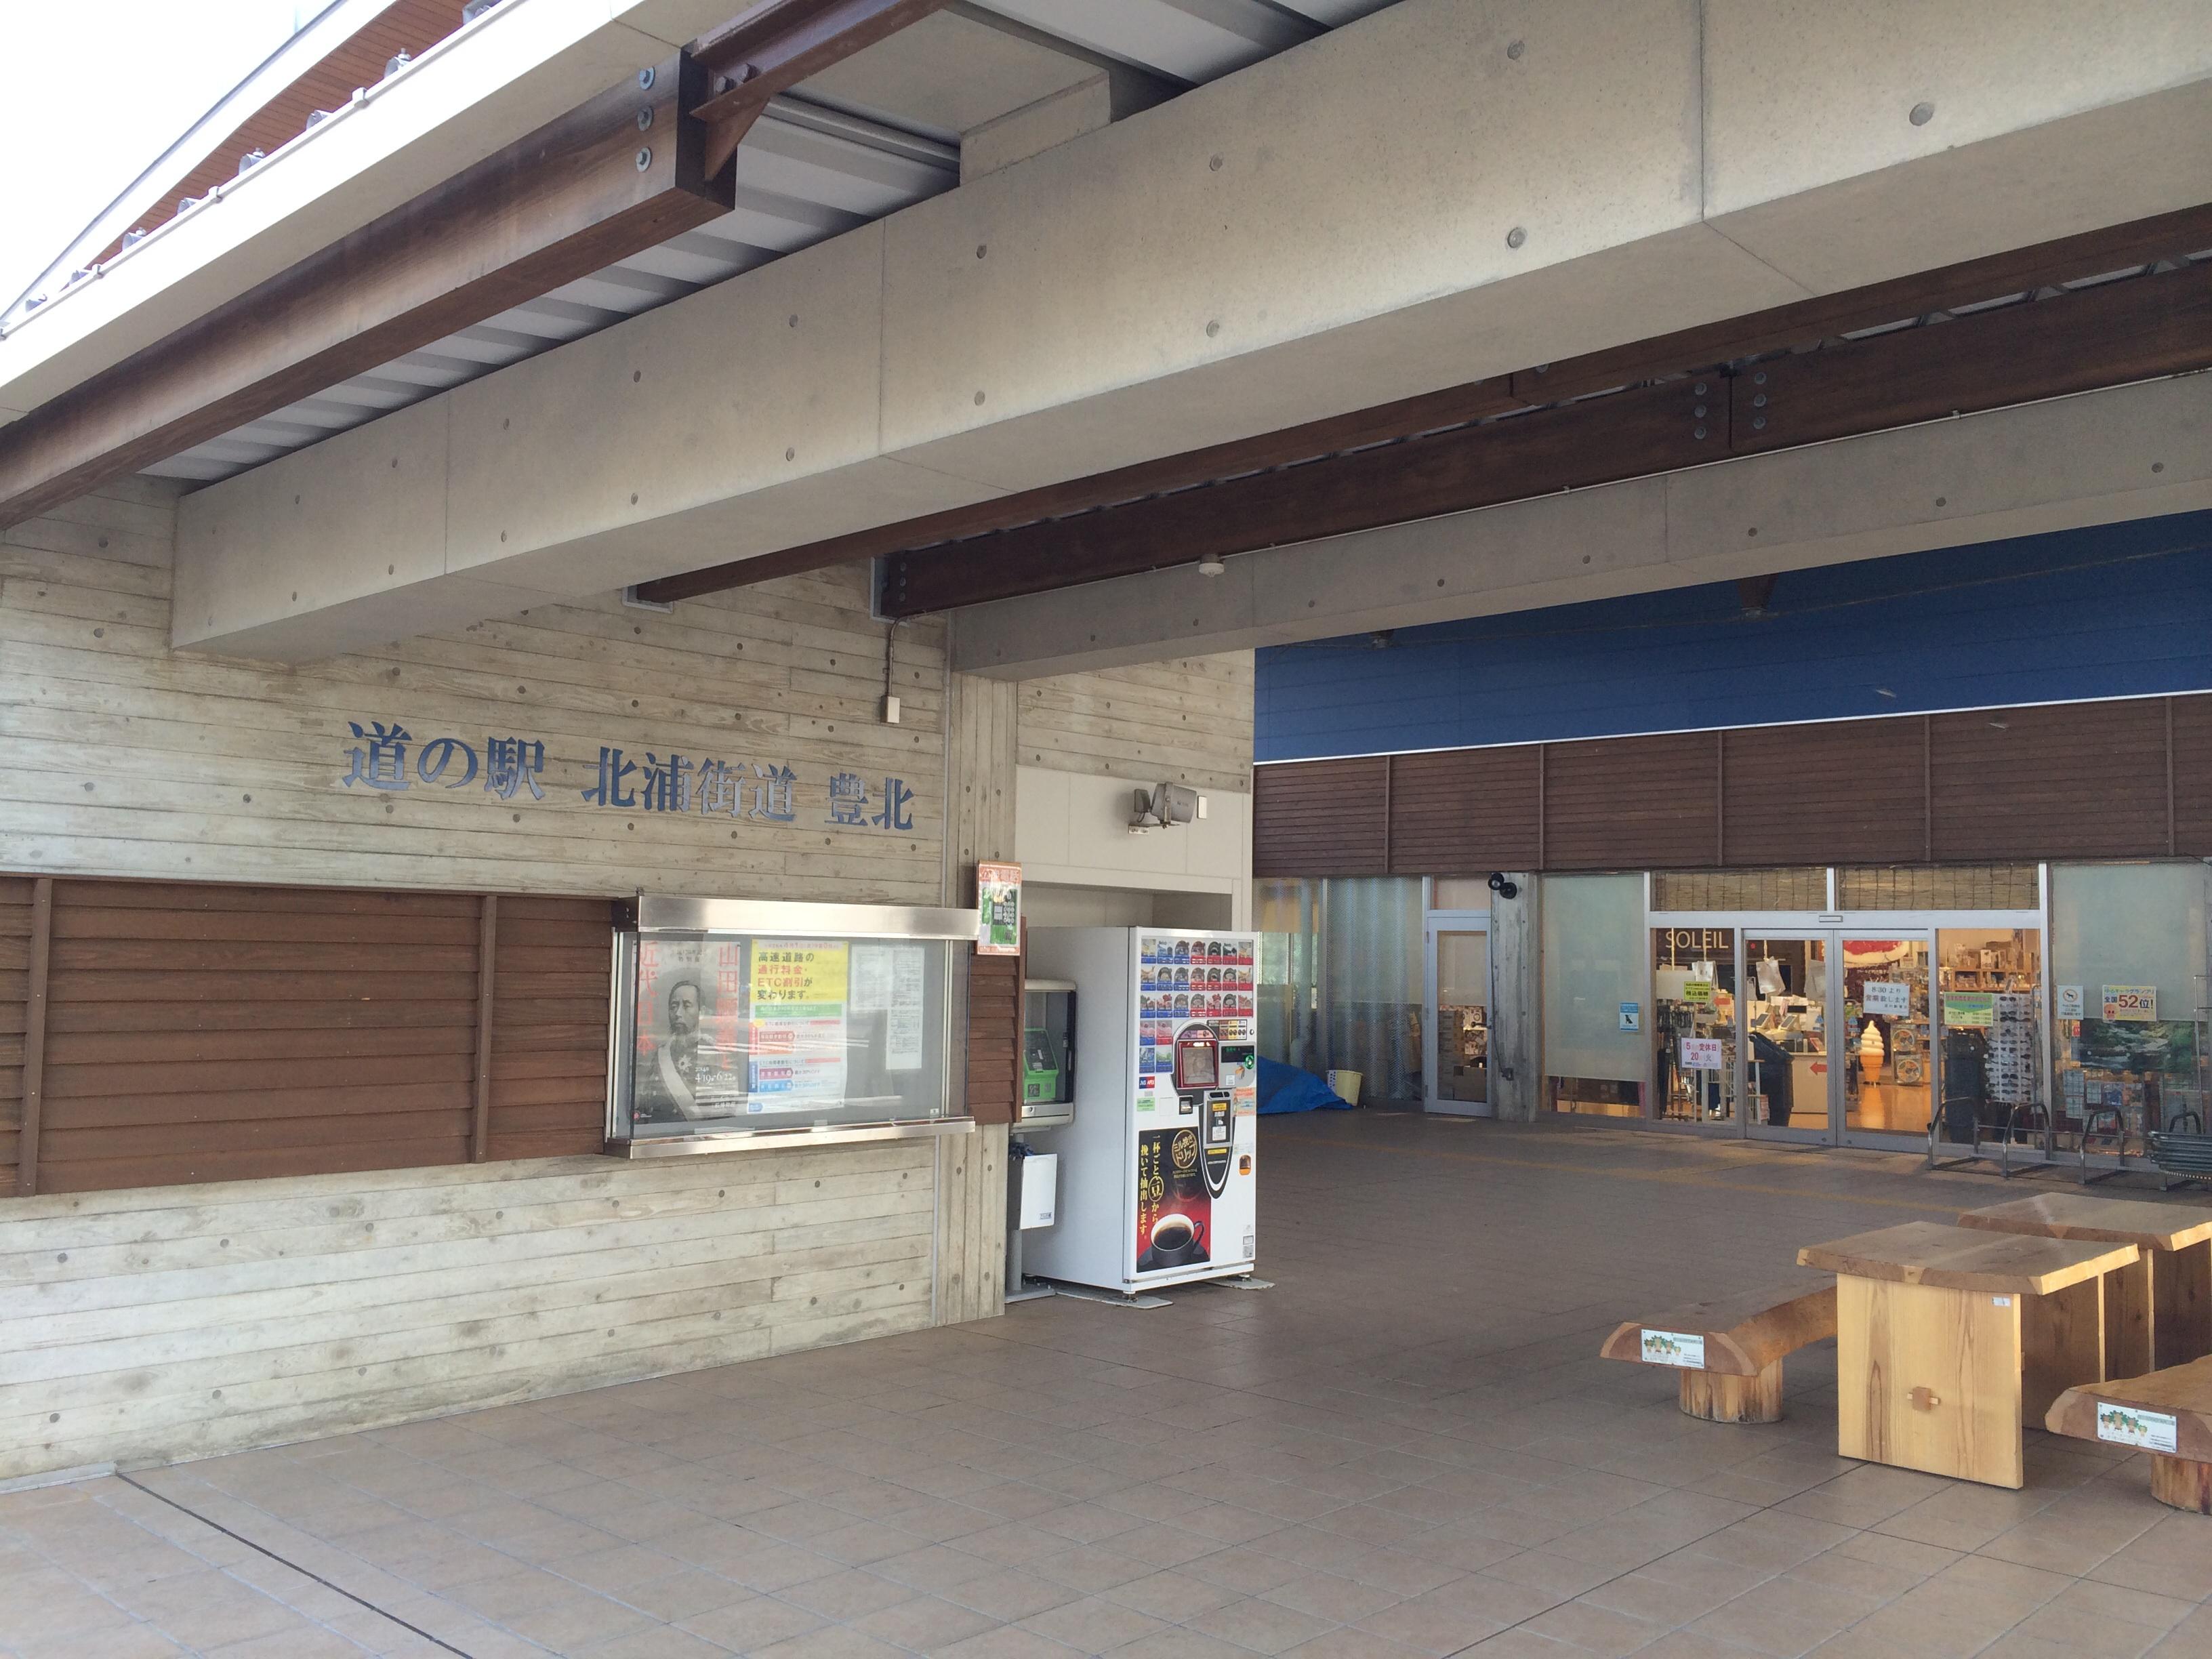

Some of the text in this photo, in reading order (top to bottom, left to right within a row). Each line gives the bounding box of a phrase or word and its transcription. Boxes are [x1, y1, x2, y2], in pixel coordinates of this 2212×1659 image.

[342, 721, 915, 831] 道の駅 北浦街道 豊北
[1666, 930, 1729, 948] SOLEIL
[758, 951, 815, 962] 高速道路の
[758, 977, 813, 987] ETC割引が
[1699, 1043, 1717, 1052] 定休日
